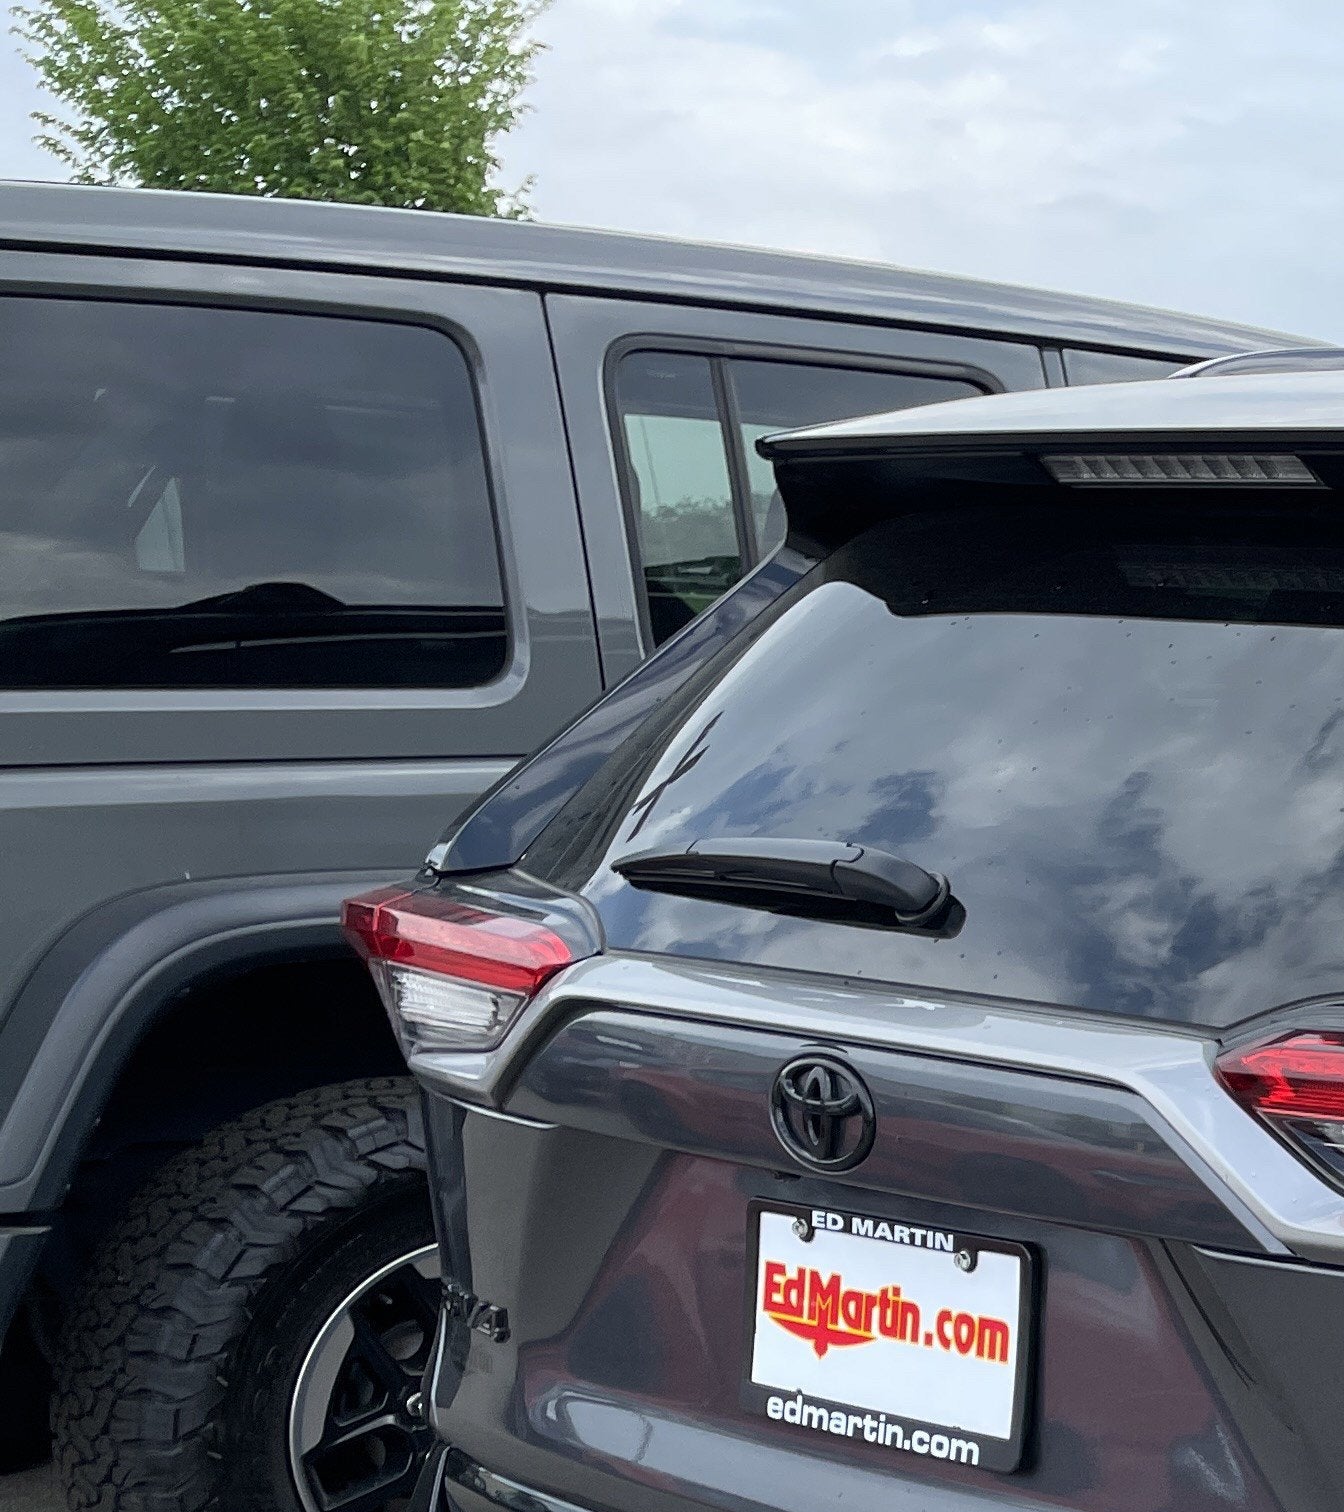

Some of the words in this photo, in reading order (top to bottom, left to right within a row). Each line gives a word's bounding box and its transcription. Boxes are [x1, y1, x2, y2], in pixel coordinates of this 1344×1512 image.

[810, 1209, 845, 1232] ED
[850, 1216, 955, 1252] MARTIN
[766, 1394, 980, 1467] edmartin.com
